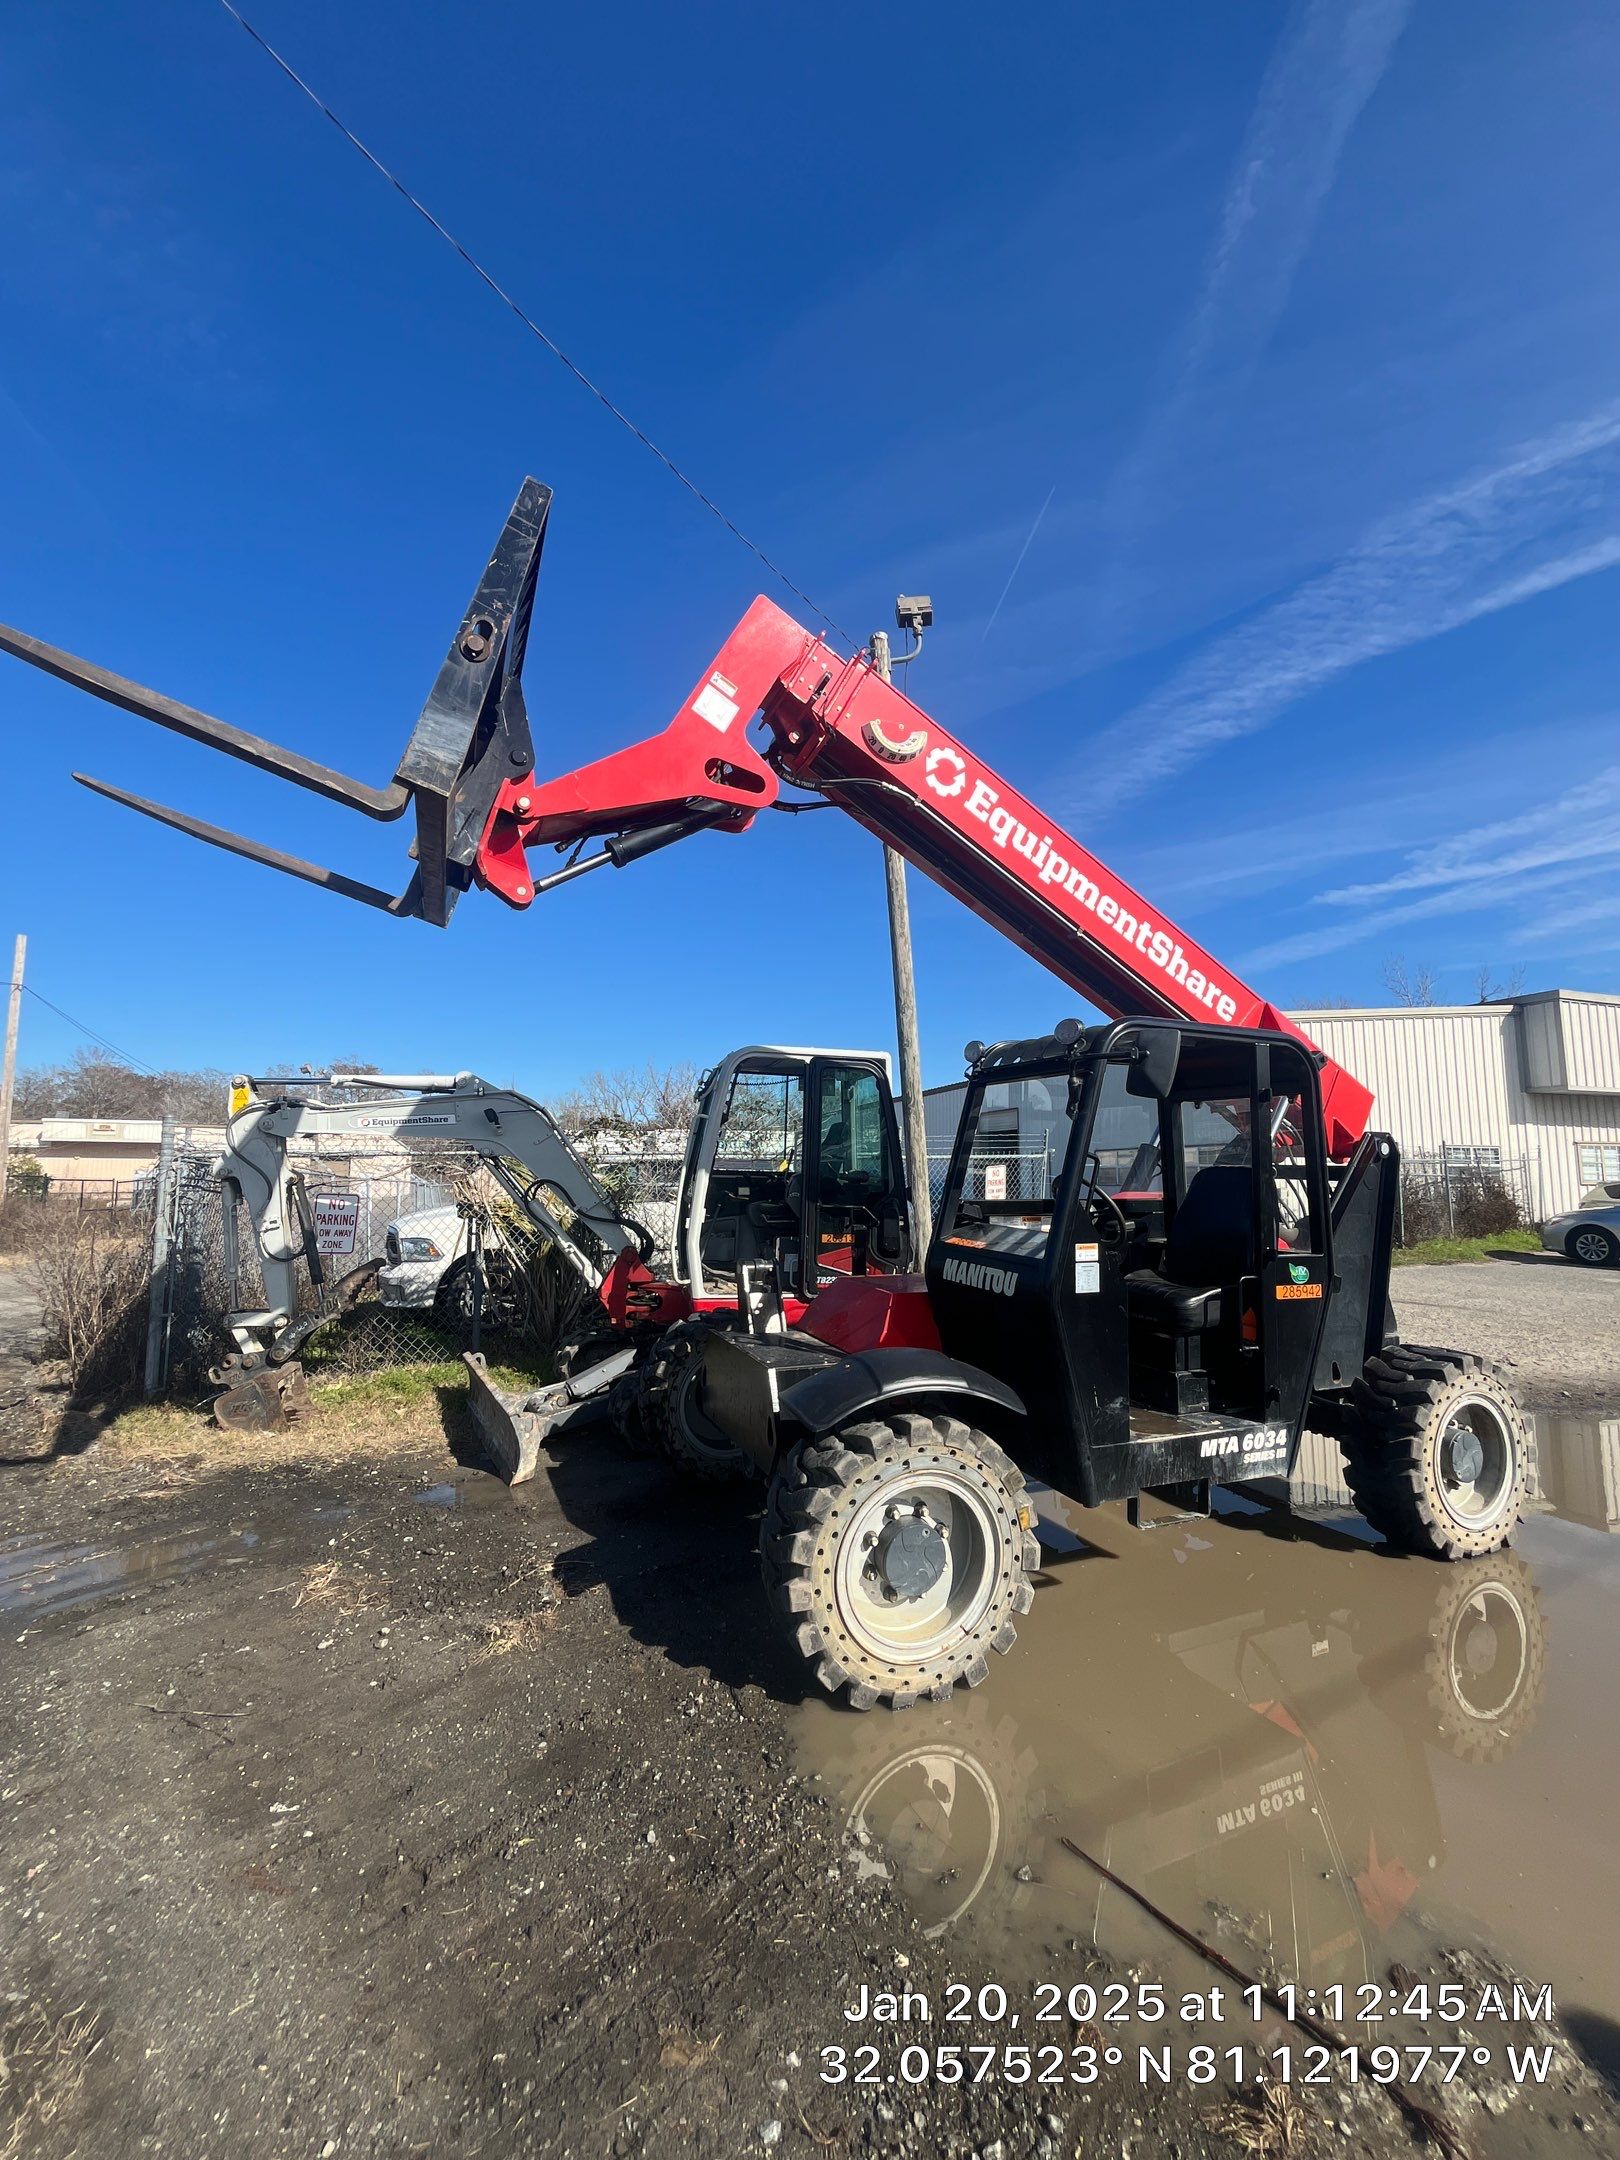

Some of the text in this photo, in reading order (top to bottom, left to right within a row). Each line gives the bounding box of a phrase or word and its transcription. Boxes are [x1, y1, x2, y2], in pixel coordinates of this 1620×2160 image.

[878, 746, 884, 754] 0
[887, 752, 896, 760] 20
[963, 778, 1237, 1022] EquipmentShare
[372, 1116, 449, 1126] EquipmentShare
[329, 1200, 345, 1210] NO
[317, 1214, 354, 1226] PARKING
[319, 1229, 331, 1237] OW
[322, 1241, 343, 1249] ZONE
[943, 1258, 1019, 1297] MANITOU
[1282, 1284, 1321, 1298] 285942
[1200, 1429, 1287, 1458] MTA 6034
[1244, 1450, 1276, 1464] SERIES
